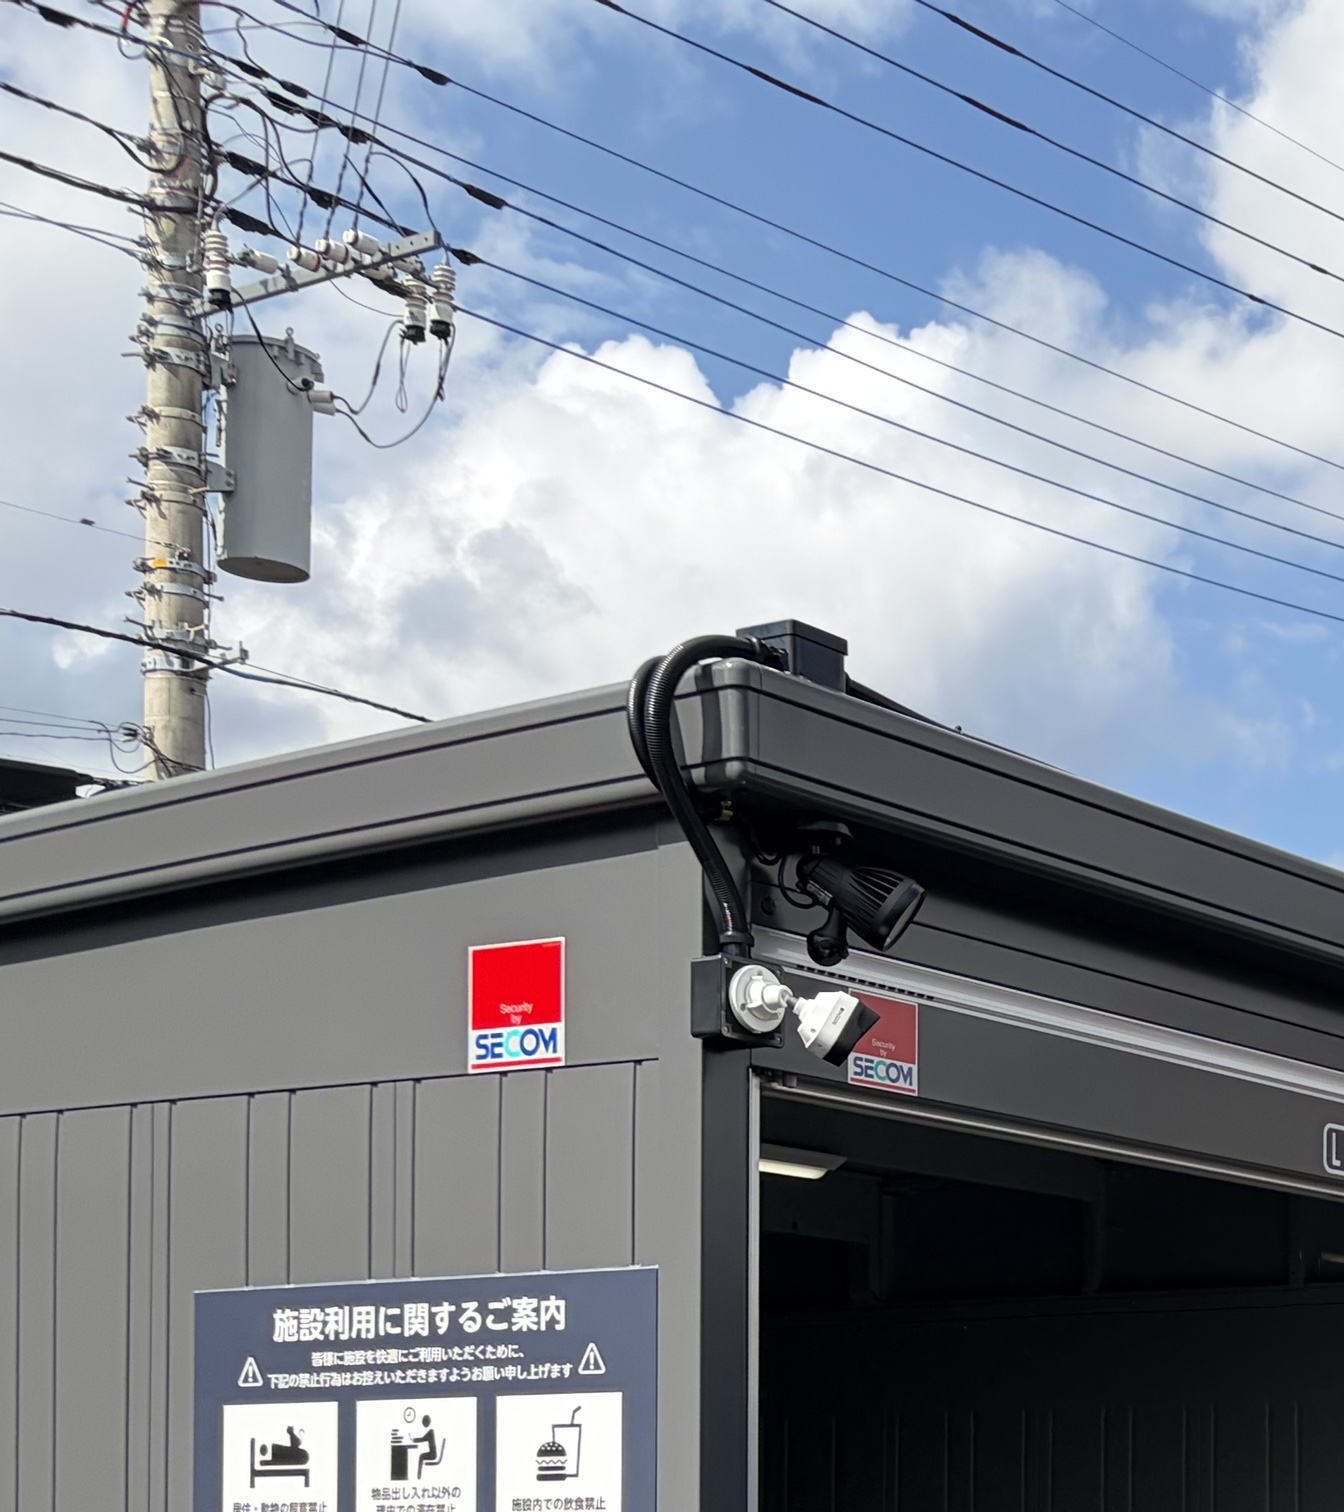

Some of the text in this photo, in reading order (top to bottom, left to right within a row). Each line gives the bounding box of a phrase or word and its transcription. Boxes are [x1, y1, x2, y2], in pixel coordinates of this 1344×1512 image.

[499, 1001, 534, 1014] Security
[510, 1013, 522, 1025] by
[475, 1027, 558, 1060] SECOM
[871, 1038, 896, 1051] Security
[853, 1056, 913, 1087] SECOM
[272, 1295, 567, 1342] 施設利用に関するご案内
[371, 1486, 462, 1500] 物品出し入れ以外の
[512, 1496, 606, 1511] 施設内での飲食禁止
